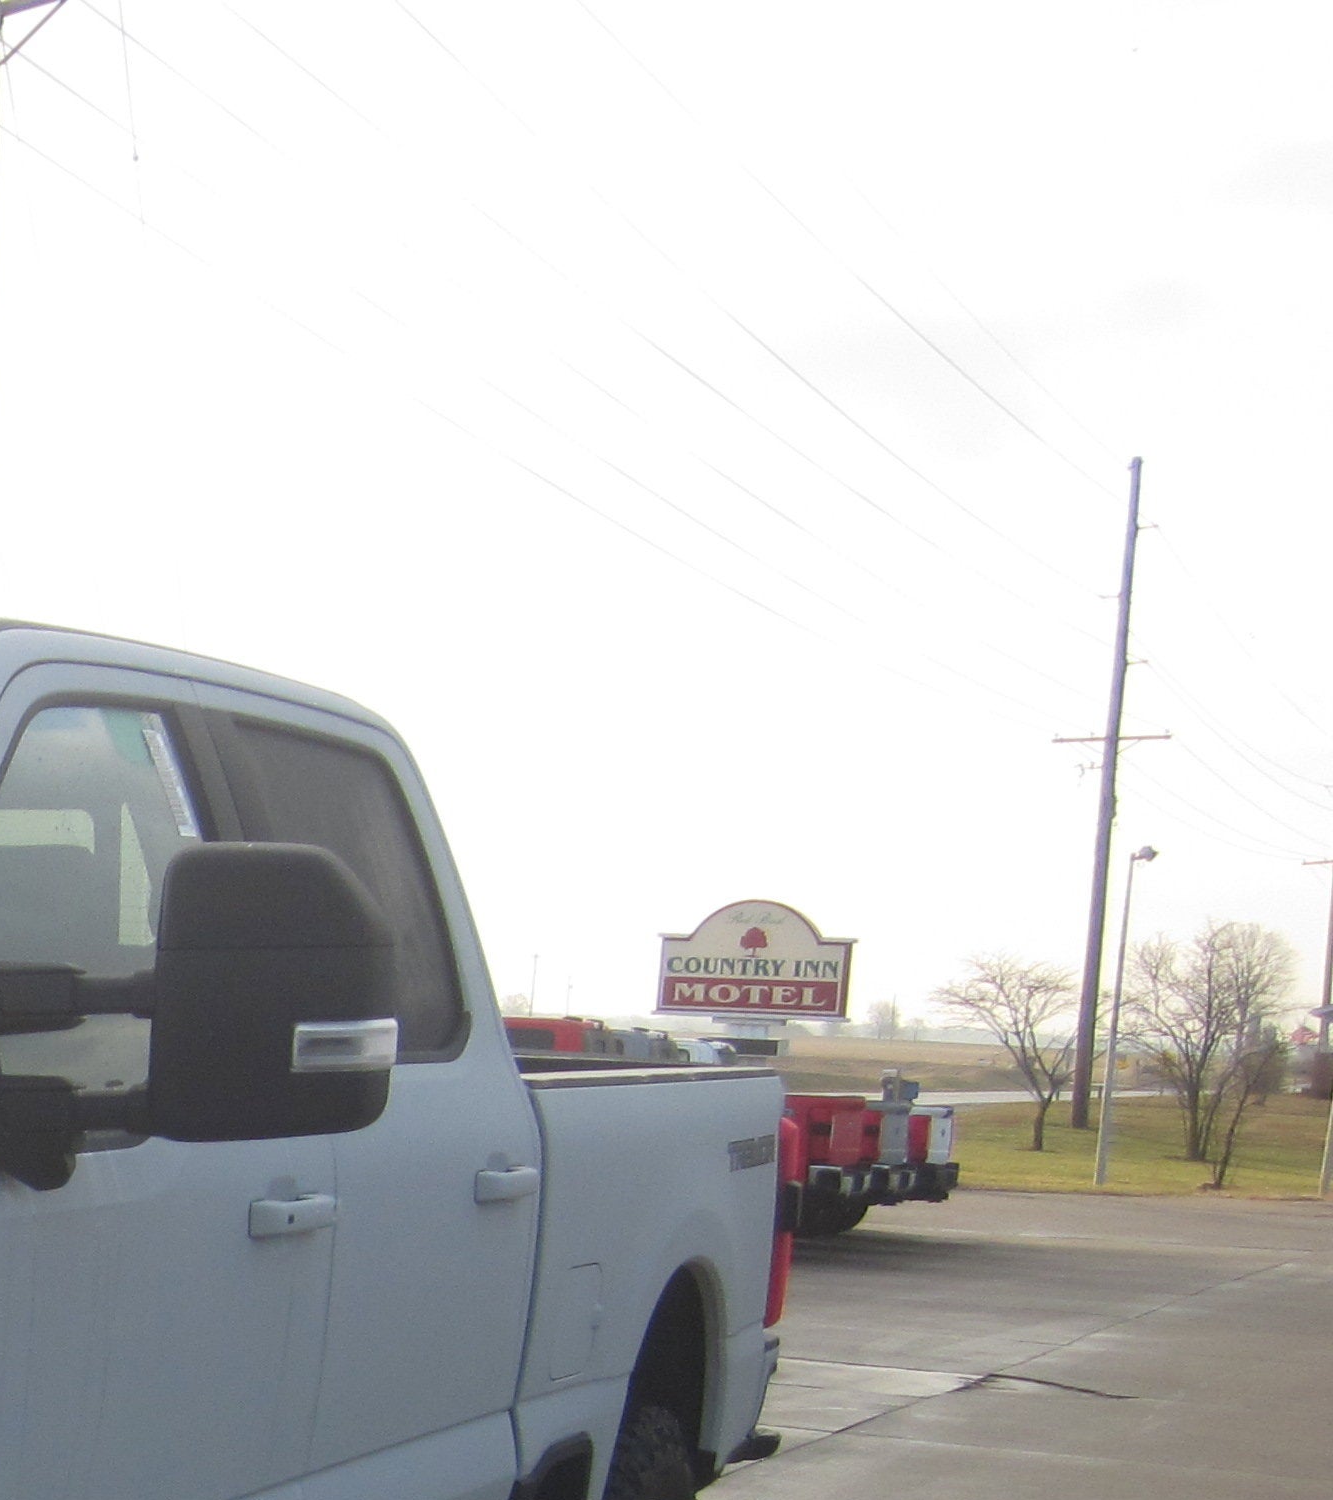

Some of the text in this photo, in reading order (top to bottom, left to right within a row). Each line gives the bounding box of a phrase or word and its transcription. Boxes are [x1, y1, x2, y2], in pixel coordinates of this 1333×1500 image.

[666, 956, 839, 979] COUNTRY INN
[673, 982, 827, 1007] MOTEL
